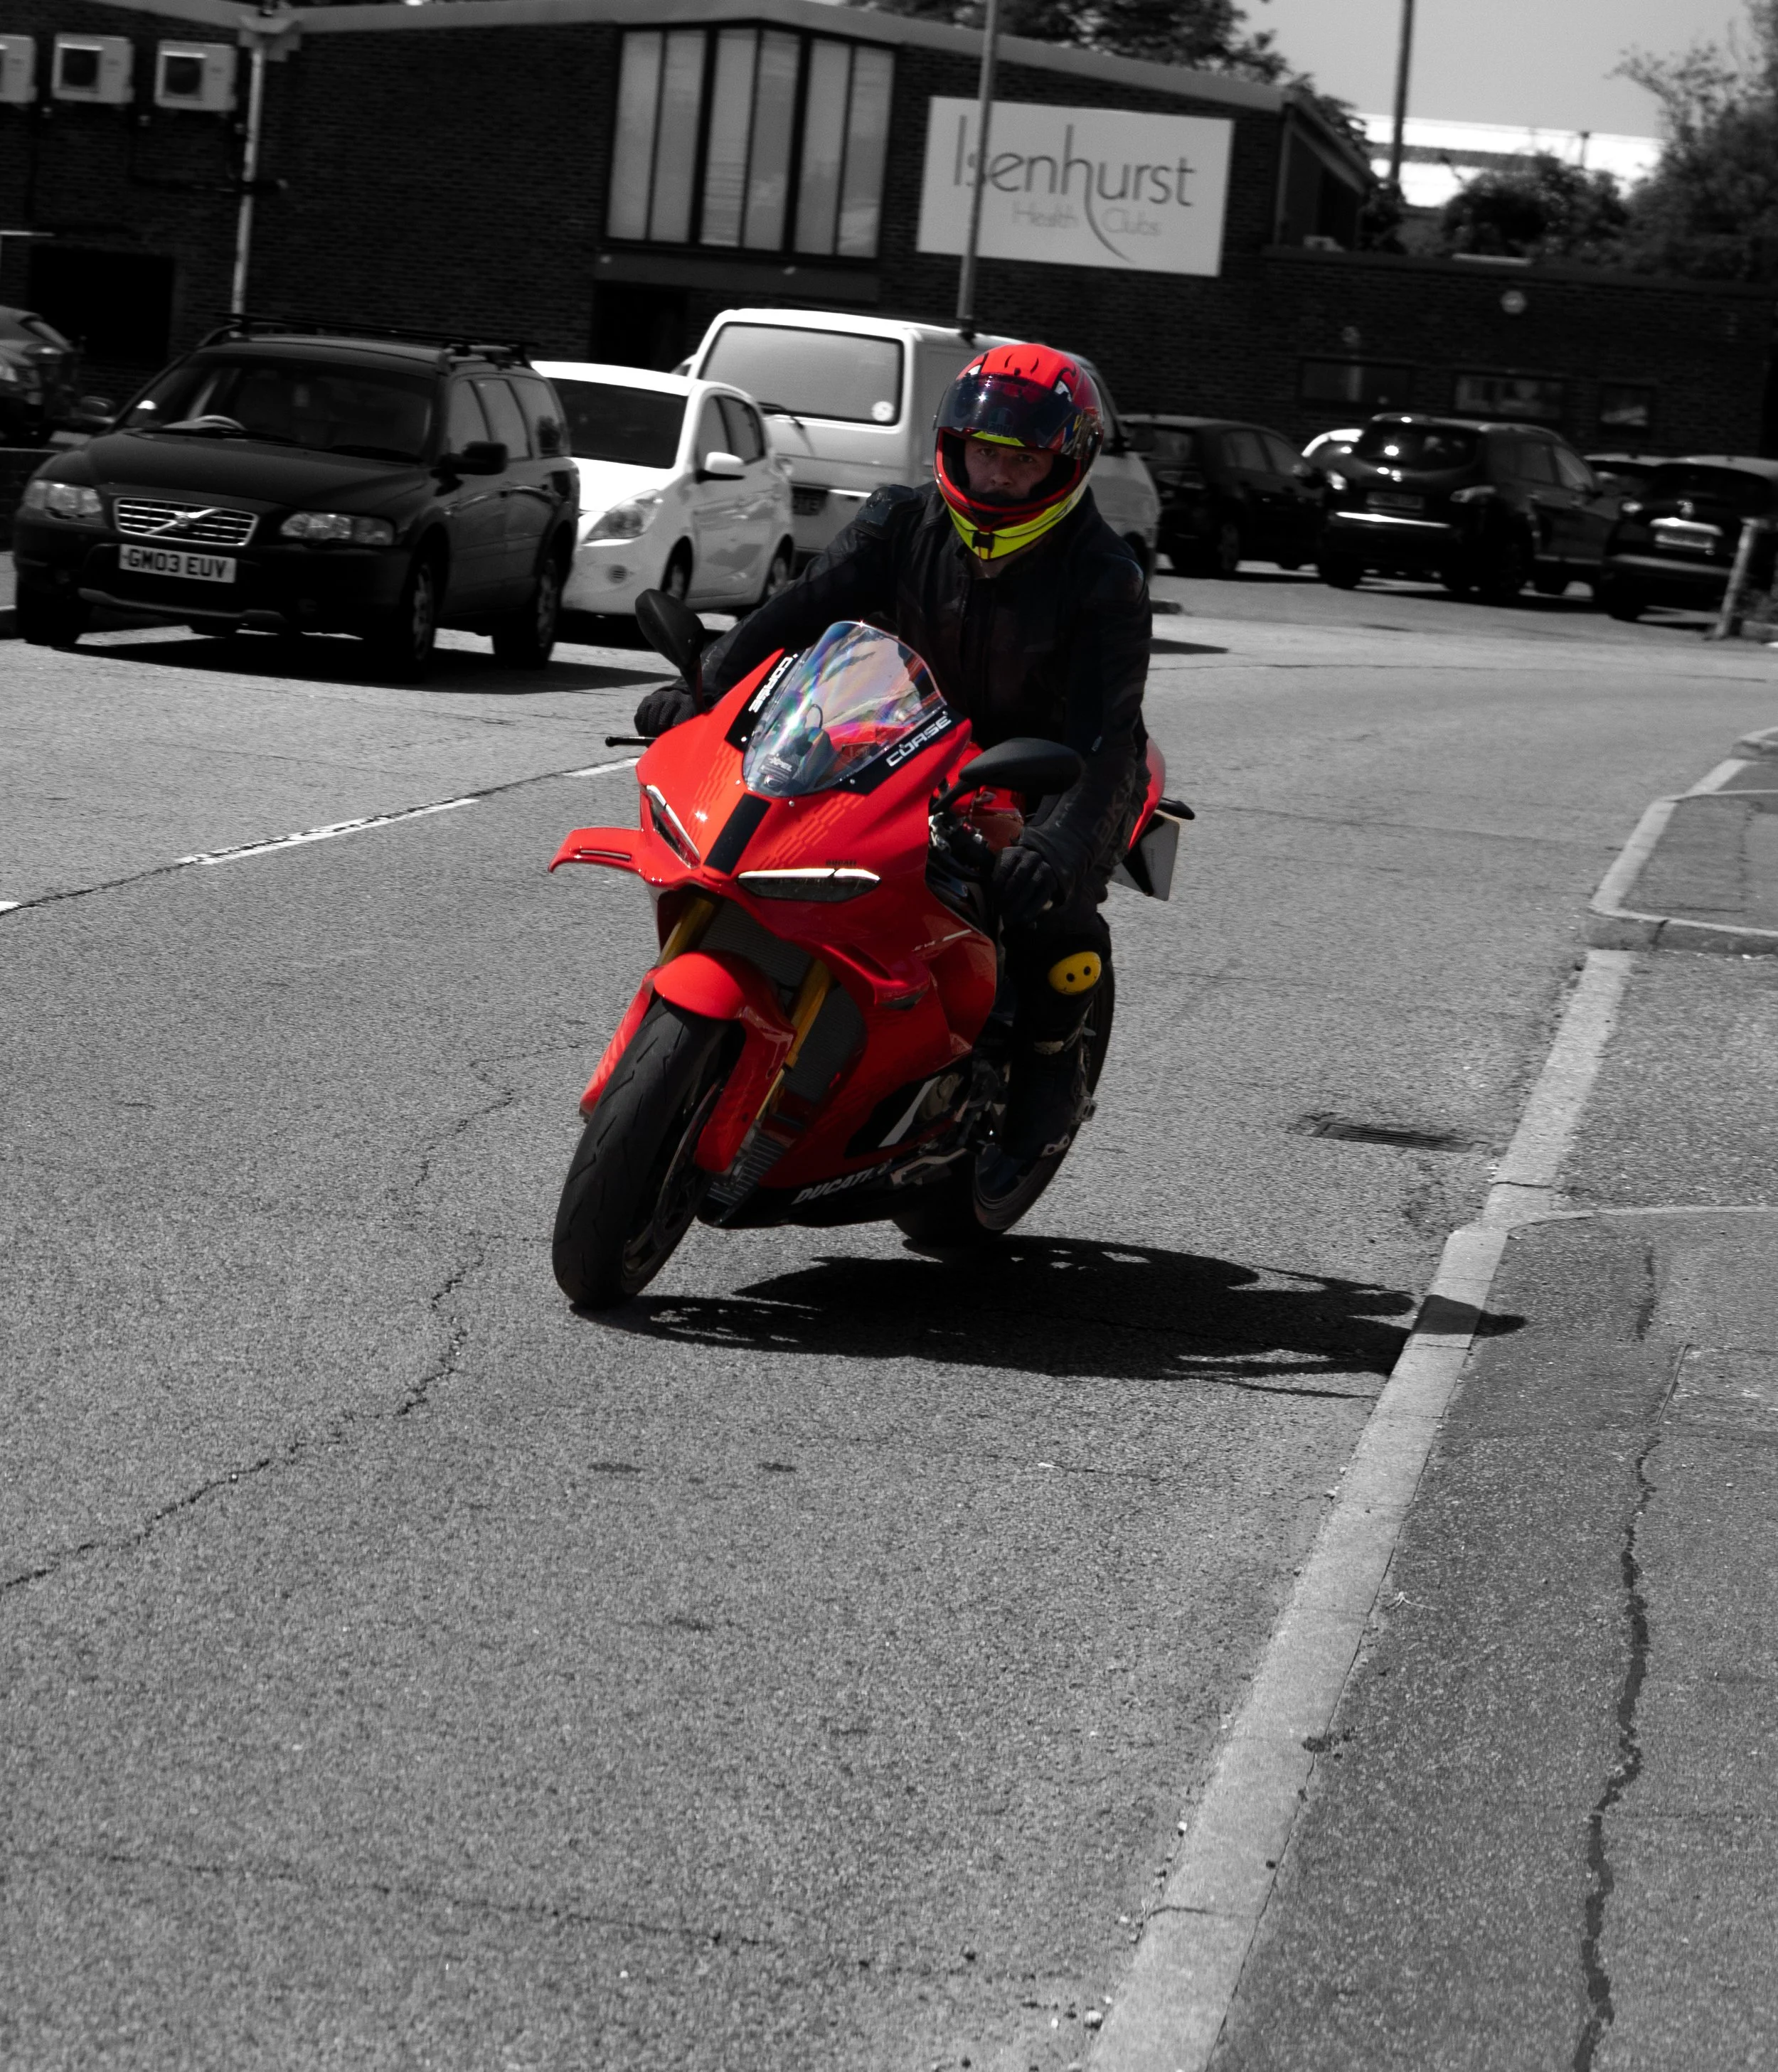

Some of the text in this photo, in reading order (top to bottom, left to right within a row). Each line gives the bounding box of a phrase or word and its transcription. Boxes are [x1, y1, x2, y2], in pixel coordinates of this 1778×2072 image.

[954, 116, 1195, 259] Isenhurst
[1012, 201, 1161, 235] Health Clubs
[128, 548, 227, 577] GM03 EUV
[748, 654, 794, 713] CORSE
[885, 712, 952, 767] CORSE
